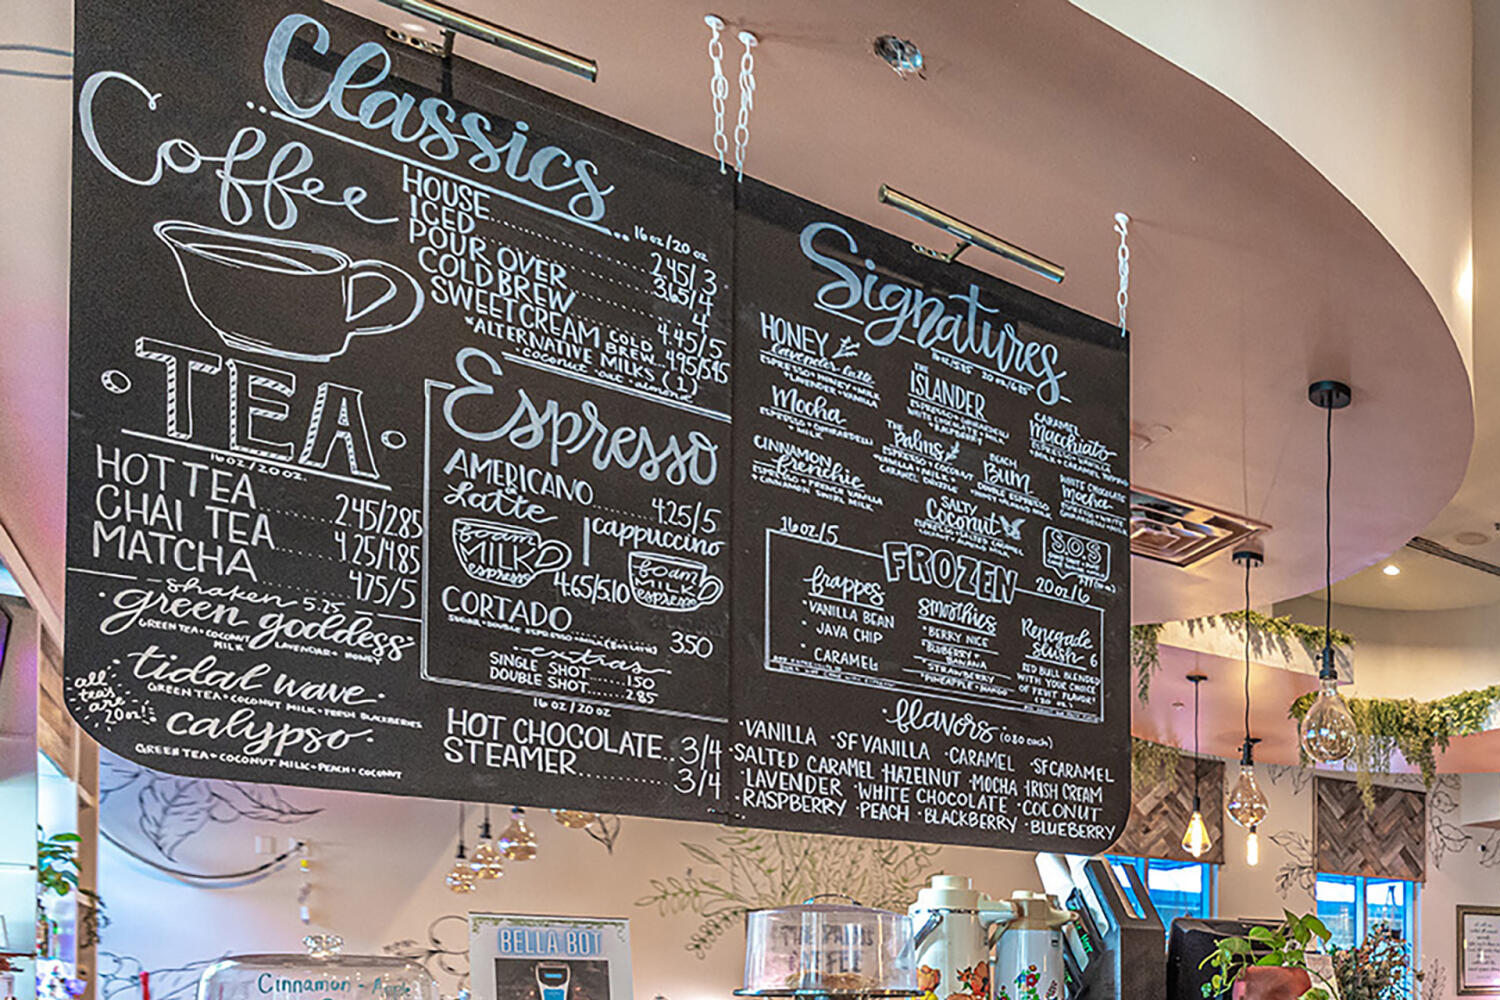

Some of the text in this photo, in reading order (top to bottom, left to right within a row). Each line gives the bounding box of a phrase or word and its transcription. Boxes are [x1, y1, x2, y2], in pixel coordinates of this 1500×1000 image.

[265, 13, 614, 221] Classics
[79, 70, 398, 230] Coffee
[402, 164, 492, 220] HOUSE
[410, 195, 475, 234] ICED
[409, 217, 709, 334] POUR OVER 4
[418, 246, 577, 314] COLD BREW
[760, 310, 830, 358] HONEY
[799, 221, 1069, 406] Signatures
[600, 351, 656, 382] MILKS
[609, 330, 653, 354] COLD
[135, 336, 380, 480] TEA
[443, 346, 719, 486] Espresso
[771, 384, 848, 425] Mocha
[909, 370, 988, 422] ISLANDER
[753, 434, 832, 468] CINNAMON
[96, 444, 175, 491] HOT
[182, 459, 257, 510] TEA
[443, 447, 594, 506] AMERICANO
[96, 484, 182, 532] CHAI
[205, 504, 275, 551] TEA
[443, 481, 727, 557] Latte cappuccino
[926, 497, 1001, 536] Coconut
[940, 495, 978, 516] SALTY
[92, 520, 258, 583] MATCHA
[459, 541, 538, 573] MILK
[632, 562, 698, 586] foam
[881, 541, 1019, 605] FROZEN
[166, 577, 346, 615] shaken 5.25
[441, 585, 573, 632] CORTADO
[634, 577, 697, 598] MILK
[803, 564, 886, 606] frappes
[100, 588, 415, 662] green goddess
[808, 599, 895, 629] VANILLA BEAN
[815, 622, 884, 644] JAVA CHIP
[74, 670, 107, 689] all
[128, 644, 378, 707] tidal wave
[489, 650, 538, 672] SINGLE
[548, 660, 591, 680] SHOT
[489, 665, 542, 687] DOUBLE
[548, 676, 589, 694] SHOT
[514, 645, 672, 675] extras
[1089, 652, 1099, 668] 6
[166, 707, 375, 758] calypso
[448, 706, 507, 741] HOT
[512, 716, 664, 760] CHOCOLATE
[678, 733, 723, 770] 3/4
[745, 718, 818, 747] VANILLA
[949, 746, 1016, 773] CARAMEL
[885, 697, 1000, 745] flavors
[443, 736, 722, 800] STEAMER 3/4
[733, 742, 1104, 804] SALTED CARAMEL HAZELNUT MOCHA IRISH CREAM
[742, 788, 1116, 841] RASPBERRY PEACH BLACKBERRY BLUEBERRY
[746, 767, 1104, 823] LAVENDER WHITE CHOCOLATE COCONUT
[499, 929, 602, 956] BELLA BOT
[258, 972, 351, 995] Cinnamon
